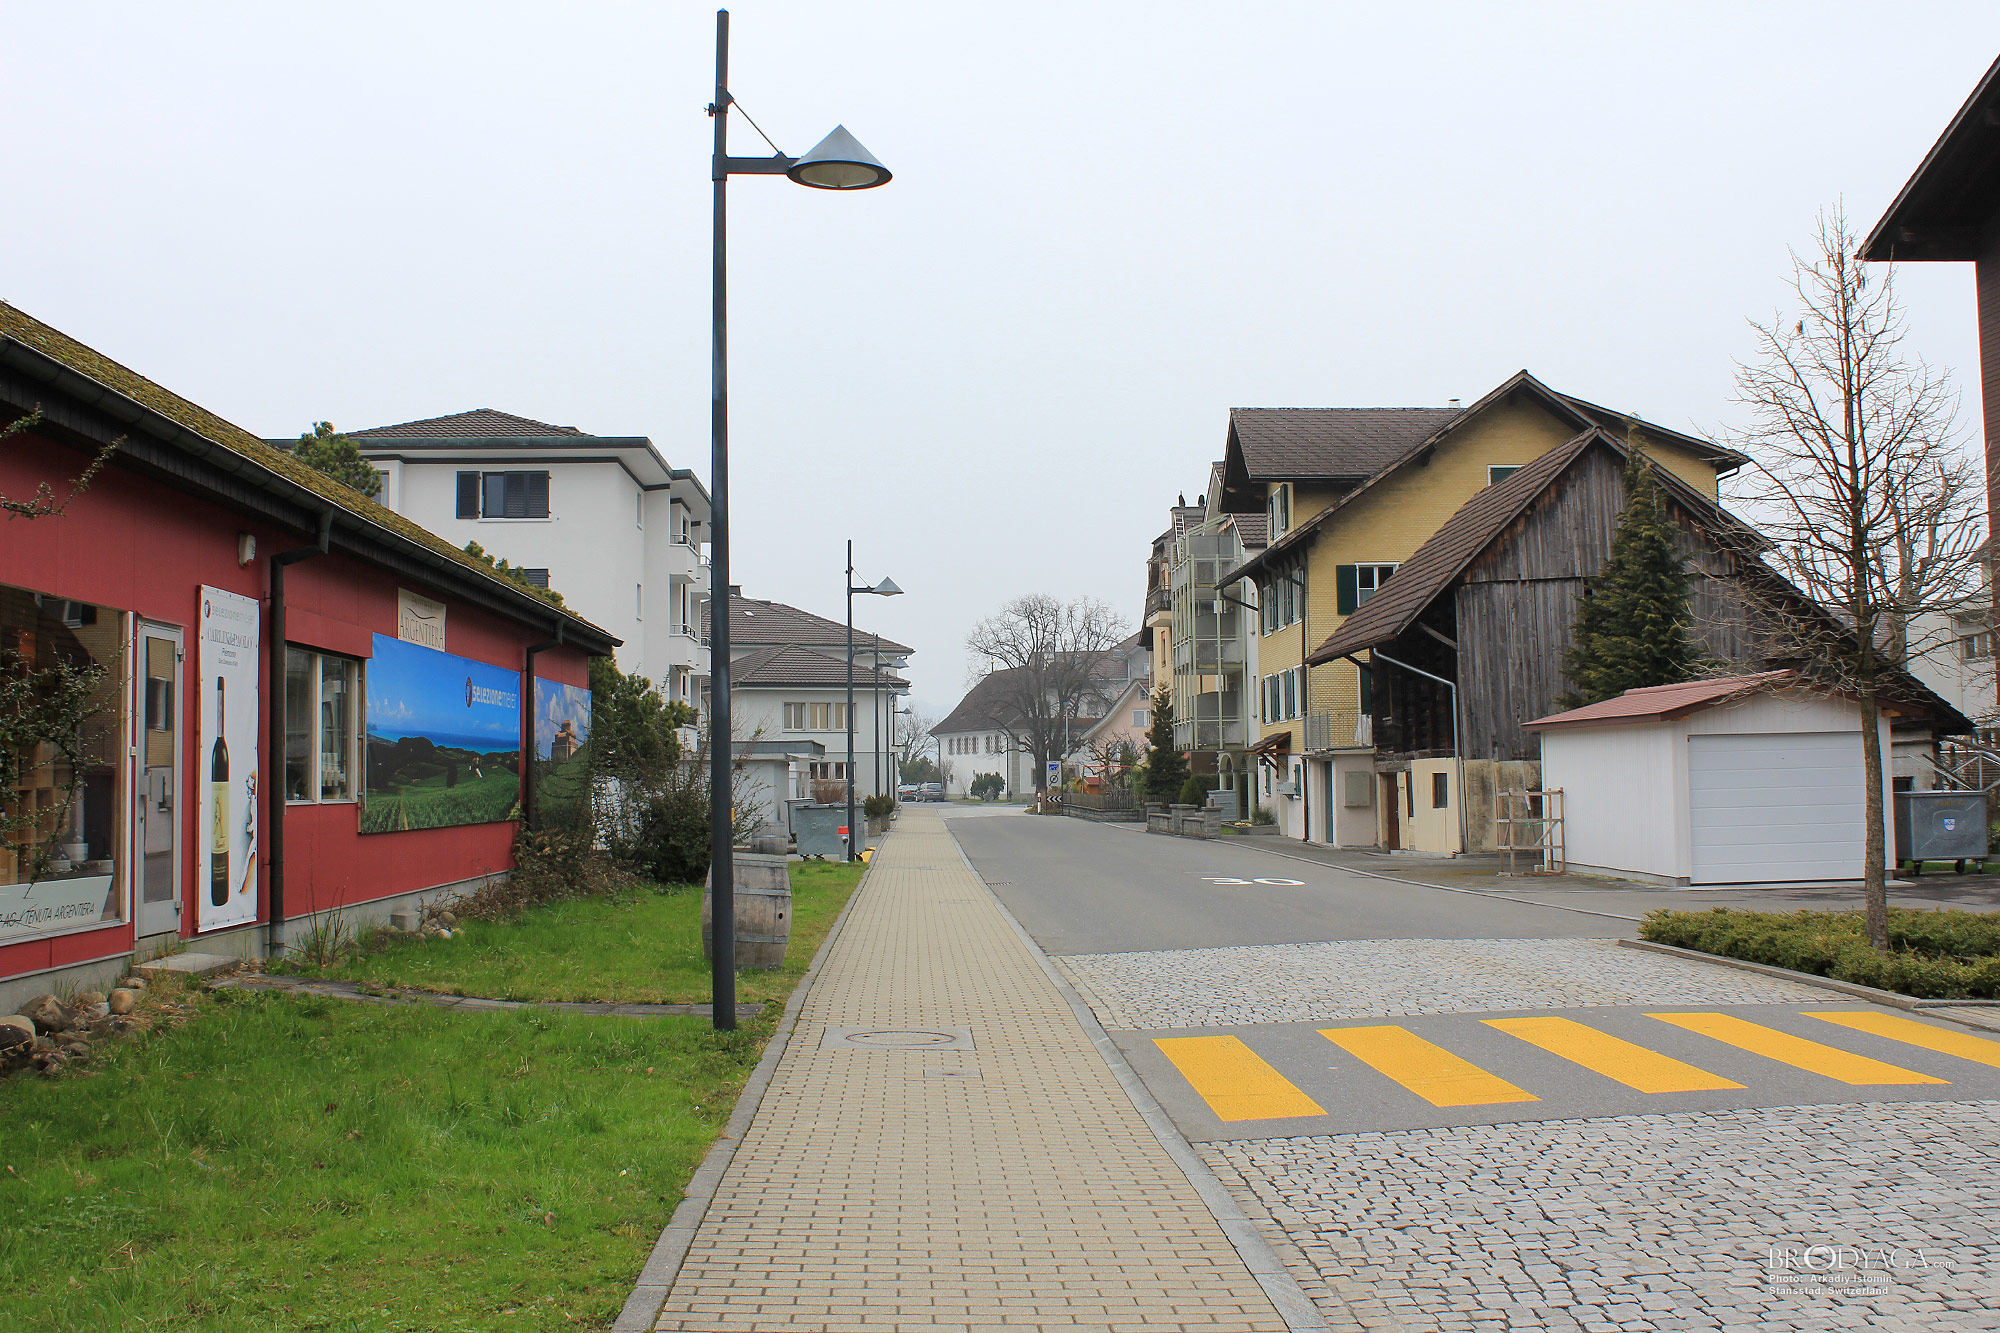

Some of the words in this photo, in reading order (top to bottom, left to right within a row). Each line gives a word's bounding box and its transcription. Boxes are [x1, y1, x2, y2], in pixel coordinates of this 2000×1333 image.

[399, 611, 445, 650] ARGENTIERA
[25, 906, 52, 925] TENUTA
[55, 902, 94, 920] ARGENTIERA
